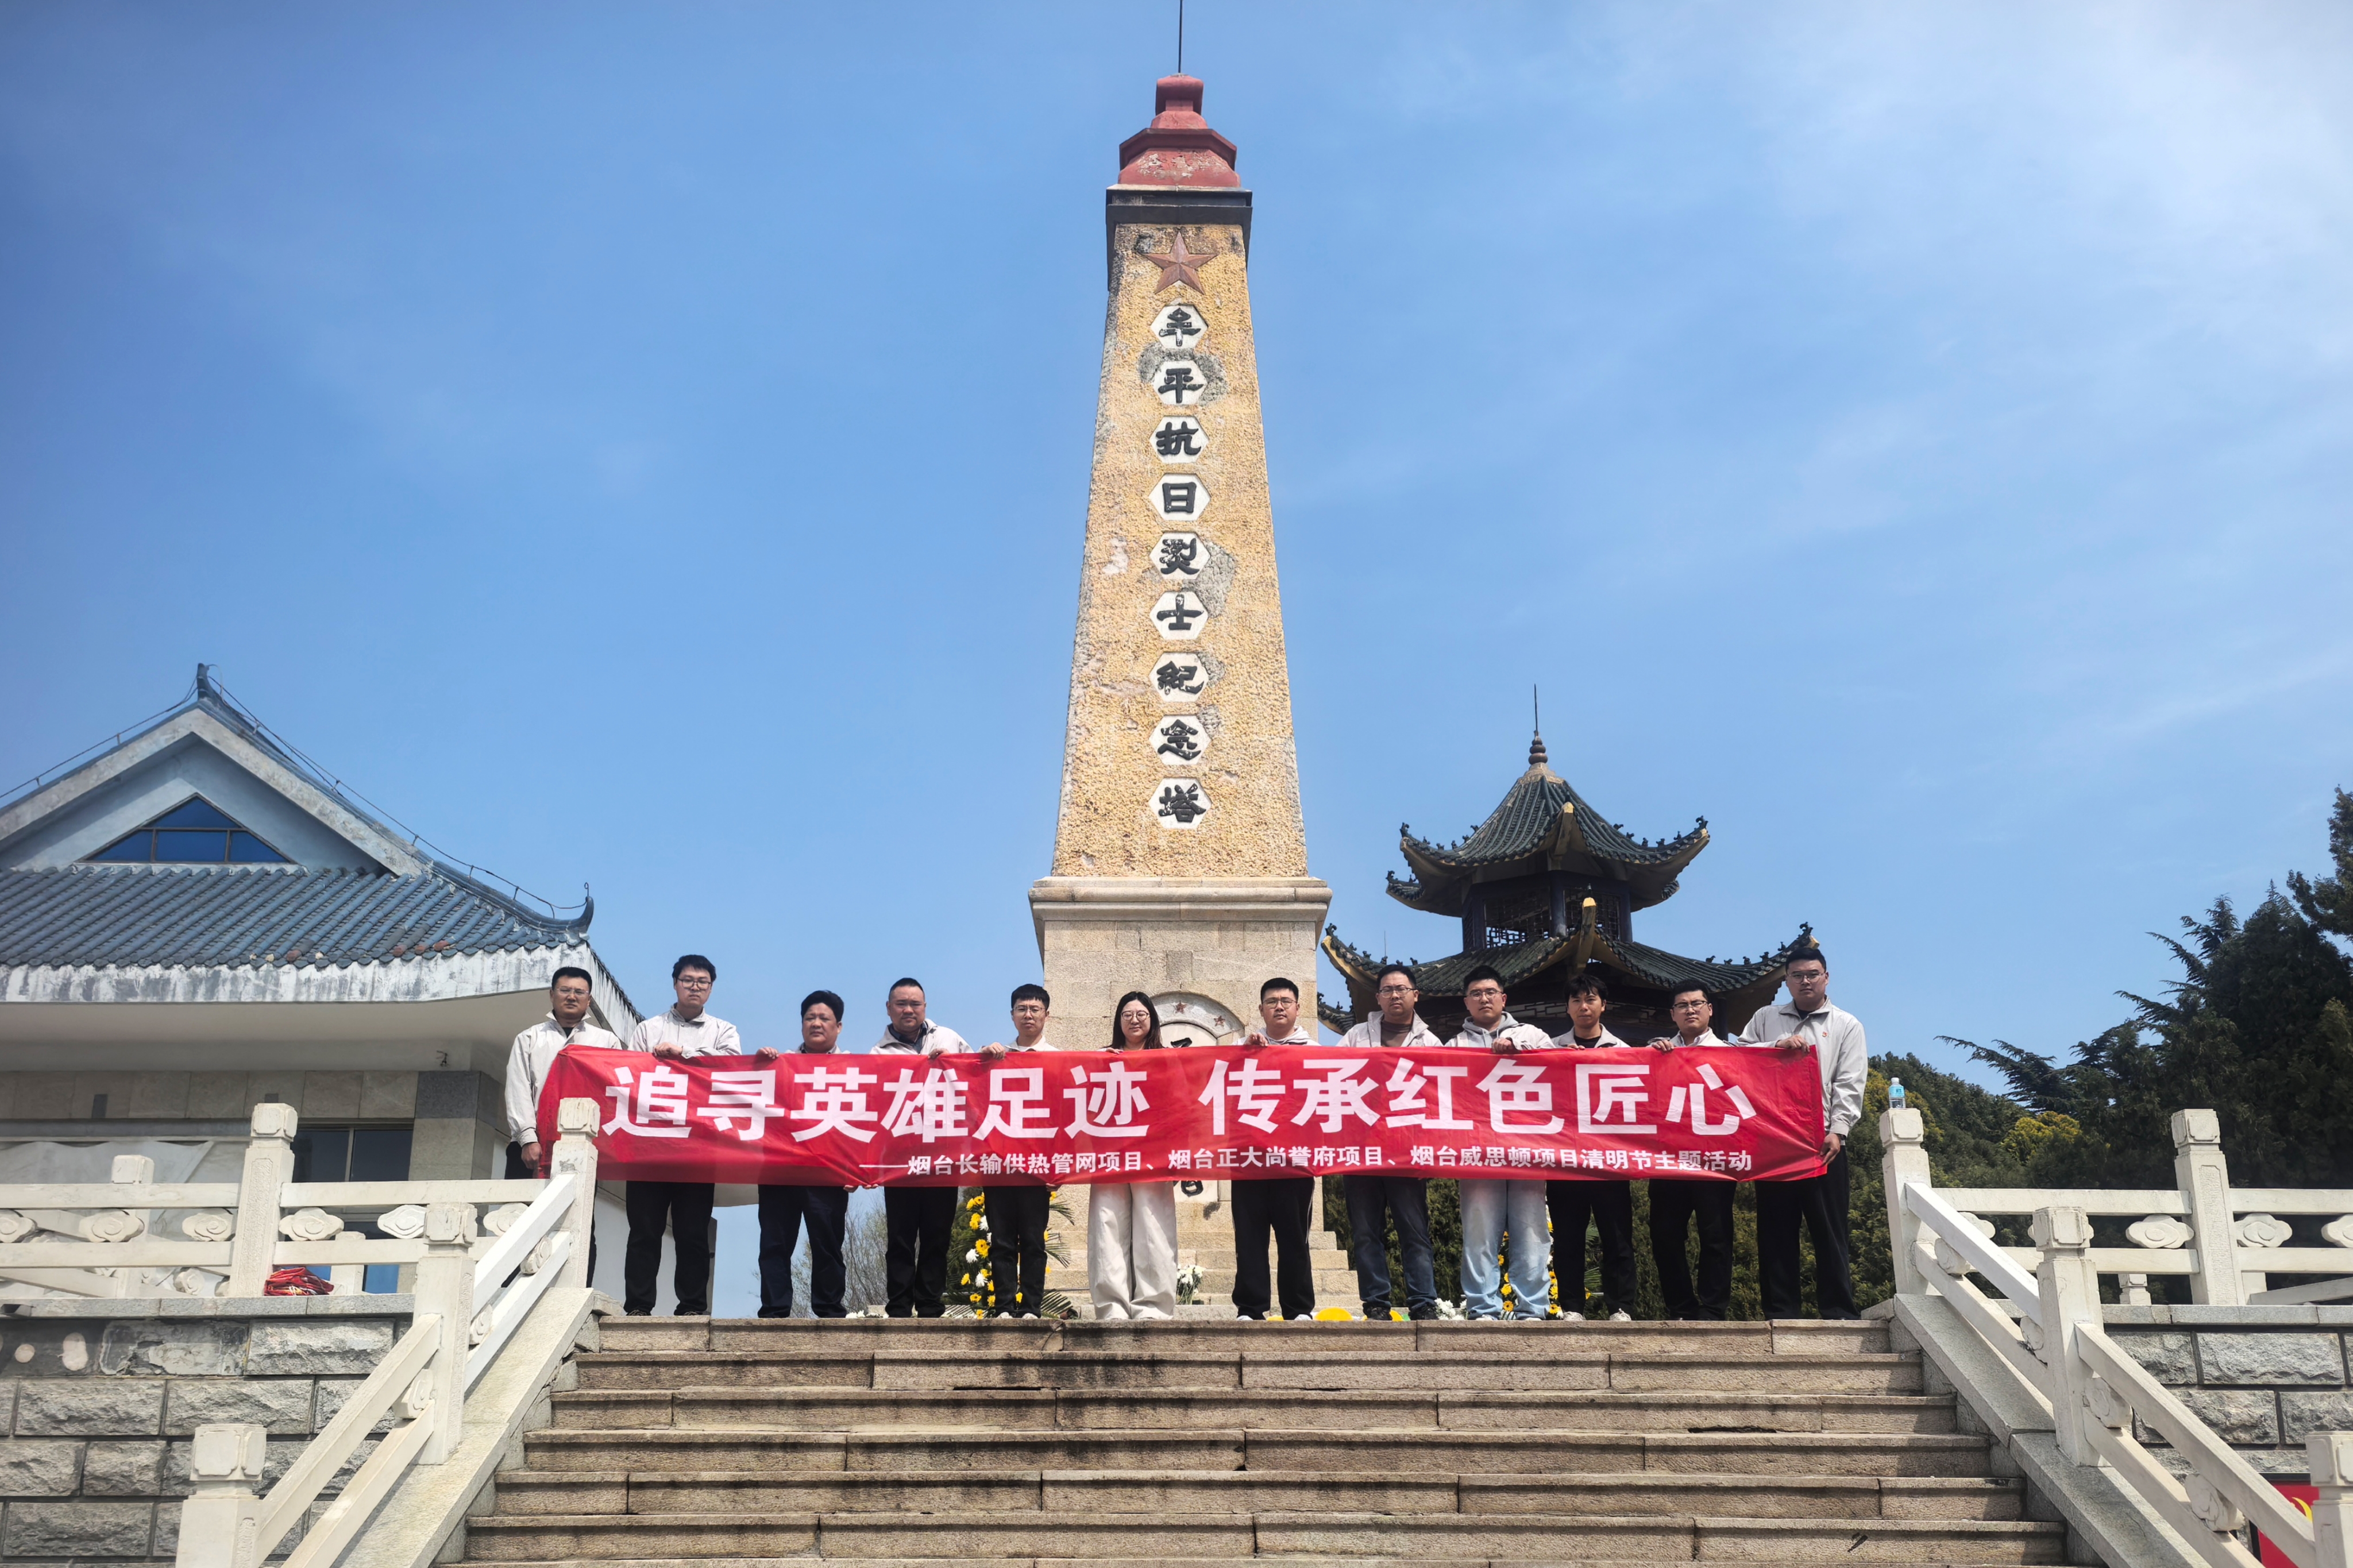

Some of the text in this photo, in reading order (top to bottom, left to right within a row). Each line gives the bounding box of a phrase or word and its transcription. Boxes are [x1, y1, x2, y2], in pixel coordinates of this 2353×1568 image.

[601, 1058, 1756, 1143] 追寻英雄足迹 传承红色匠心
